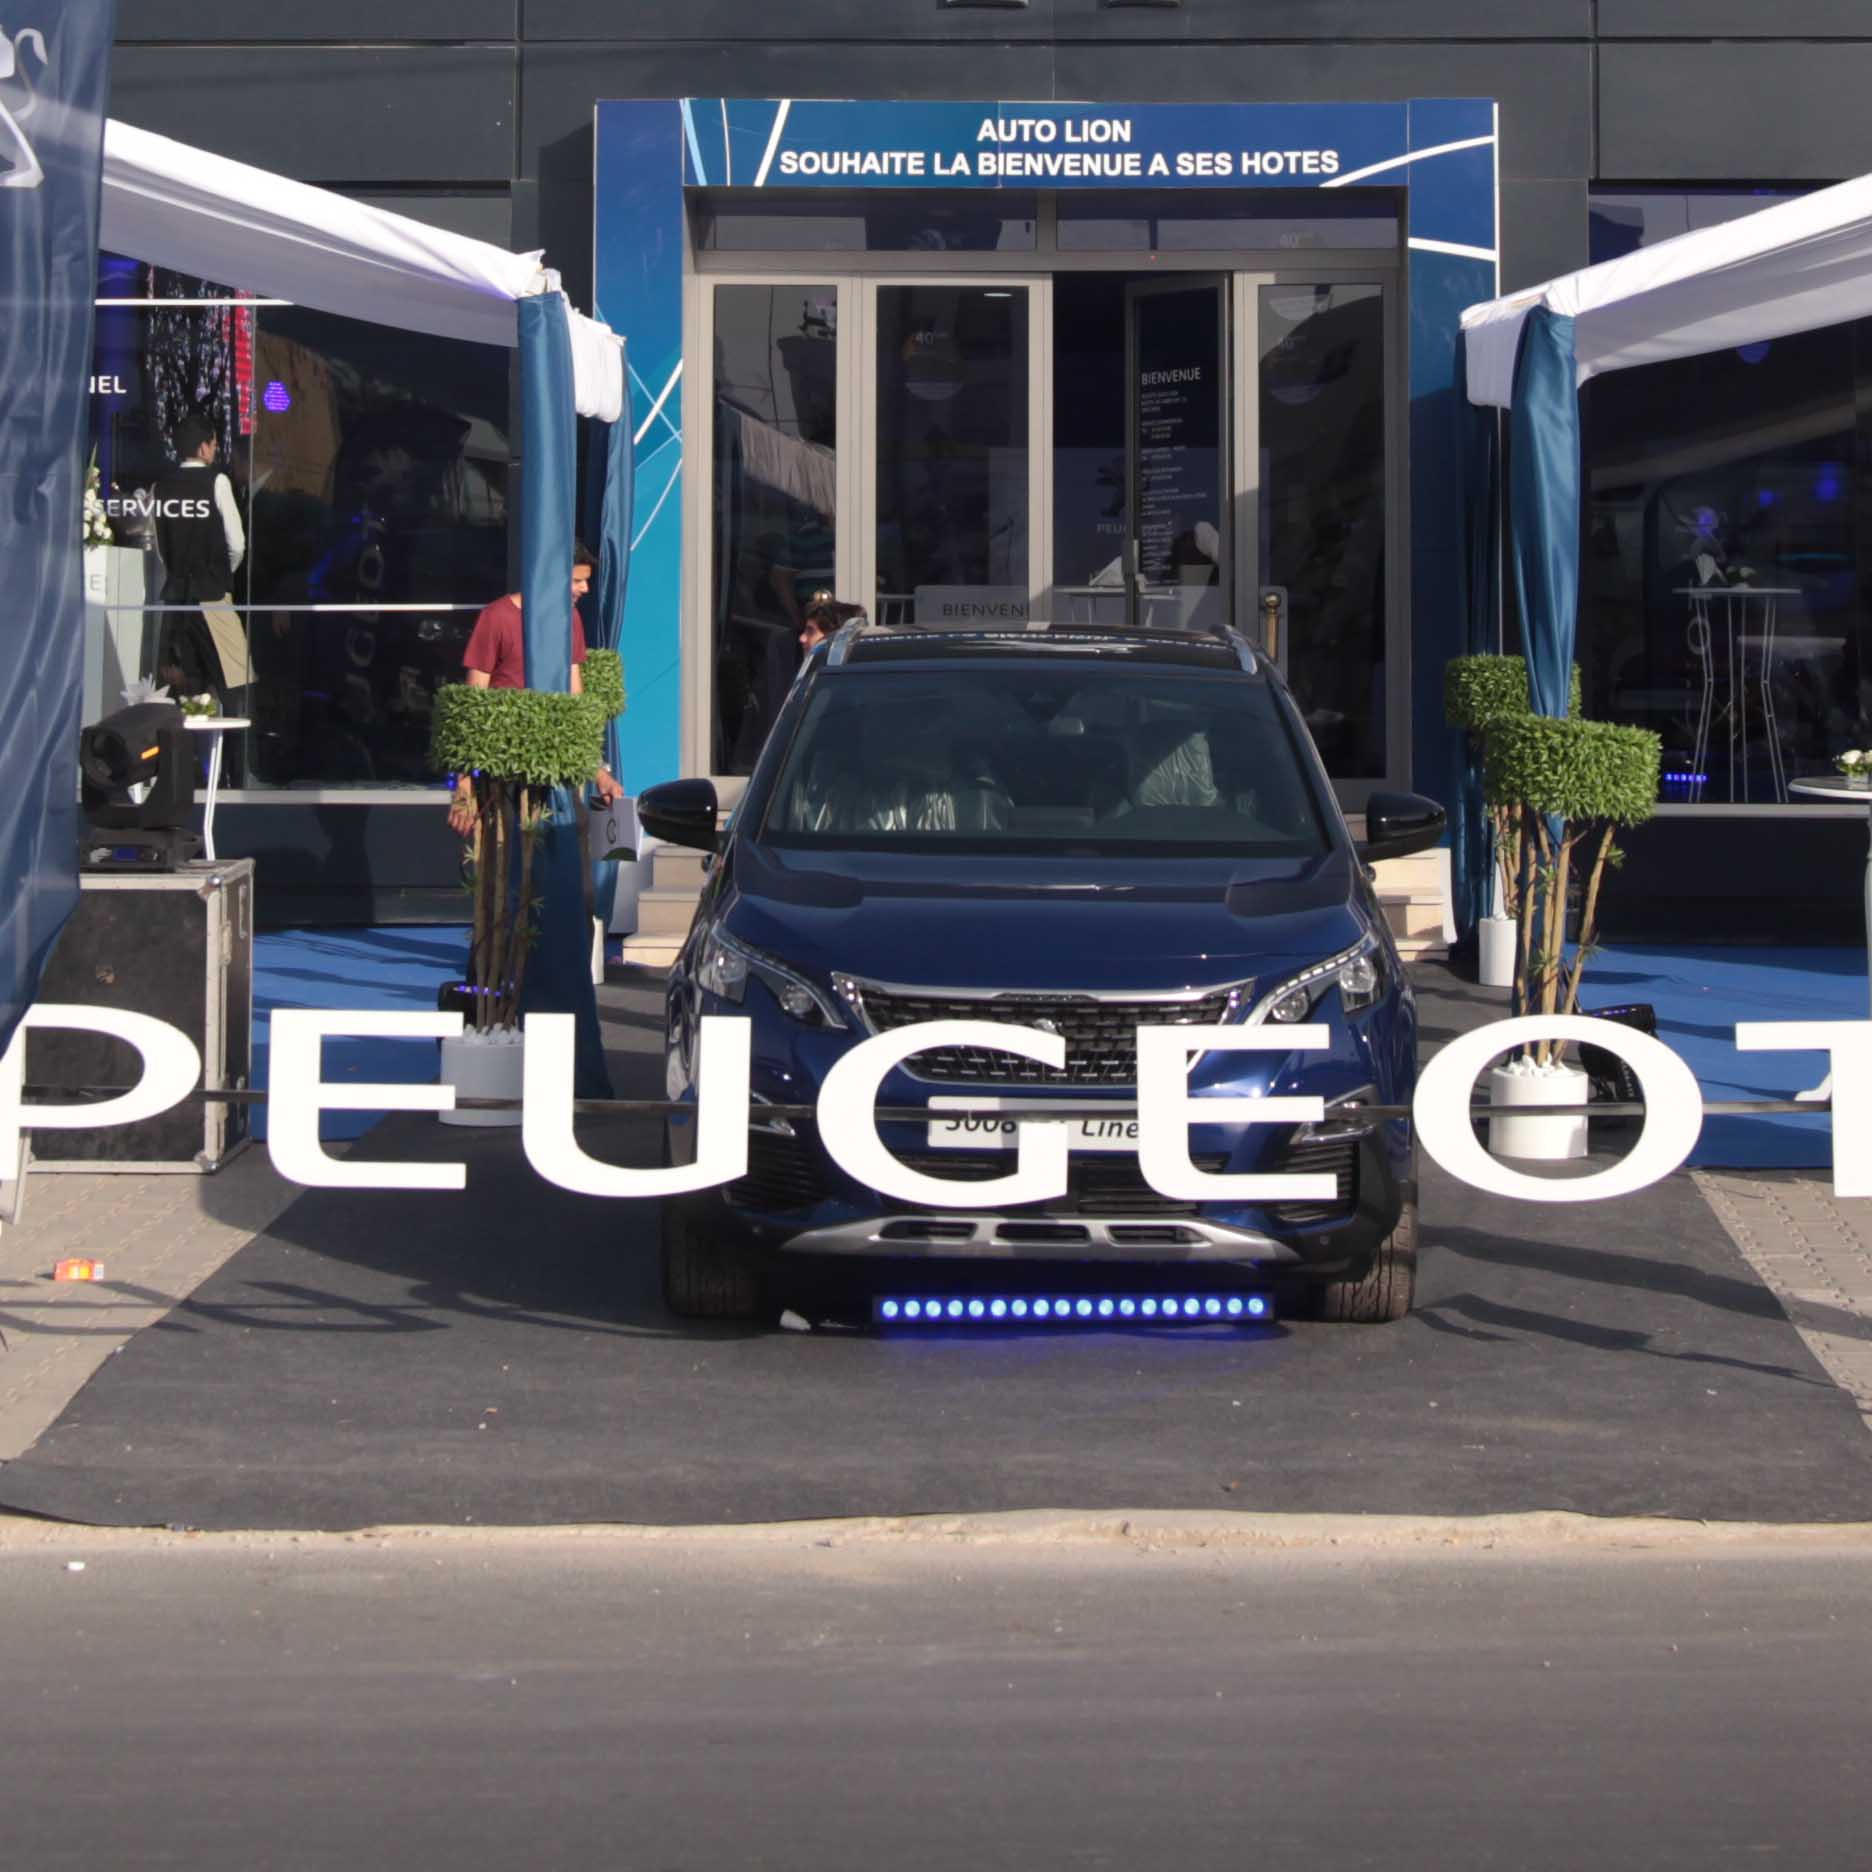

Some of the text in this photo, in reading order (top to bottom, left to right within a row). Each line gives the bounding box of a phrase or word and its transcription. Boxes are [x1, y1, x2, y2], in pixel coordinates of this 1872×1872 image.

[977, 119, 1132, 143] AUTO LION
[779, 150, 1340, 176] SOUHAITE LA BIENVENUE A SES HOTES
[1141, 366, 1202, 386] BIENVENUE
[942, 602, 1028, 617] BIENVEN
